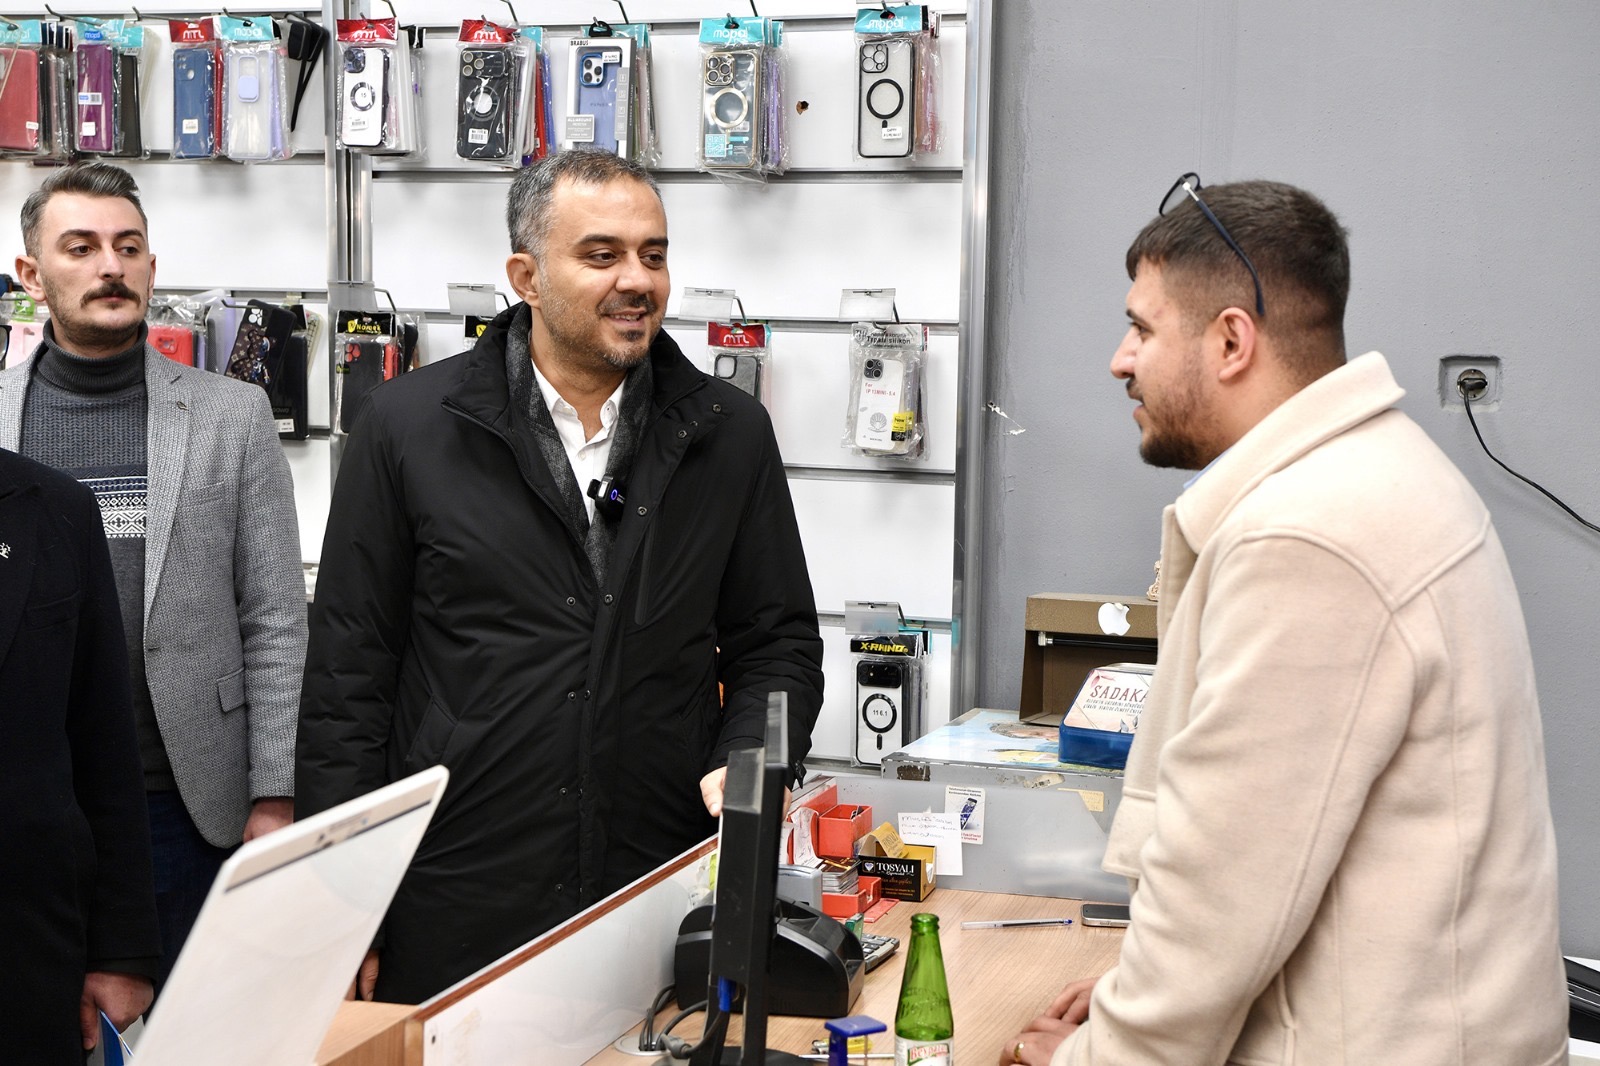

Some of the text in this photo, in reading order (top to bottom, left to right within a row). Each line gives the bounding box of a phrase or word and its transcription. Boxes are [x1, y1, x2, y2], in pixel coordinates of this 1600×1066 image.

[723, 334, 750, 344] MTL
[860, 642, 904, 653] X-RHINO
[876, 862, 914, 873] TOSYALI
